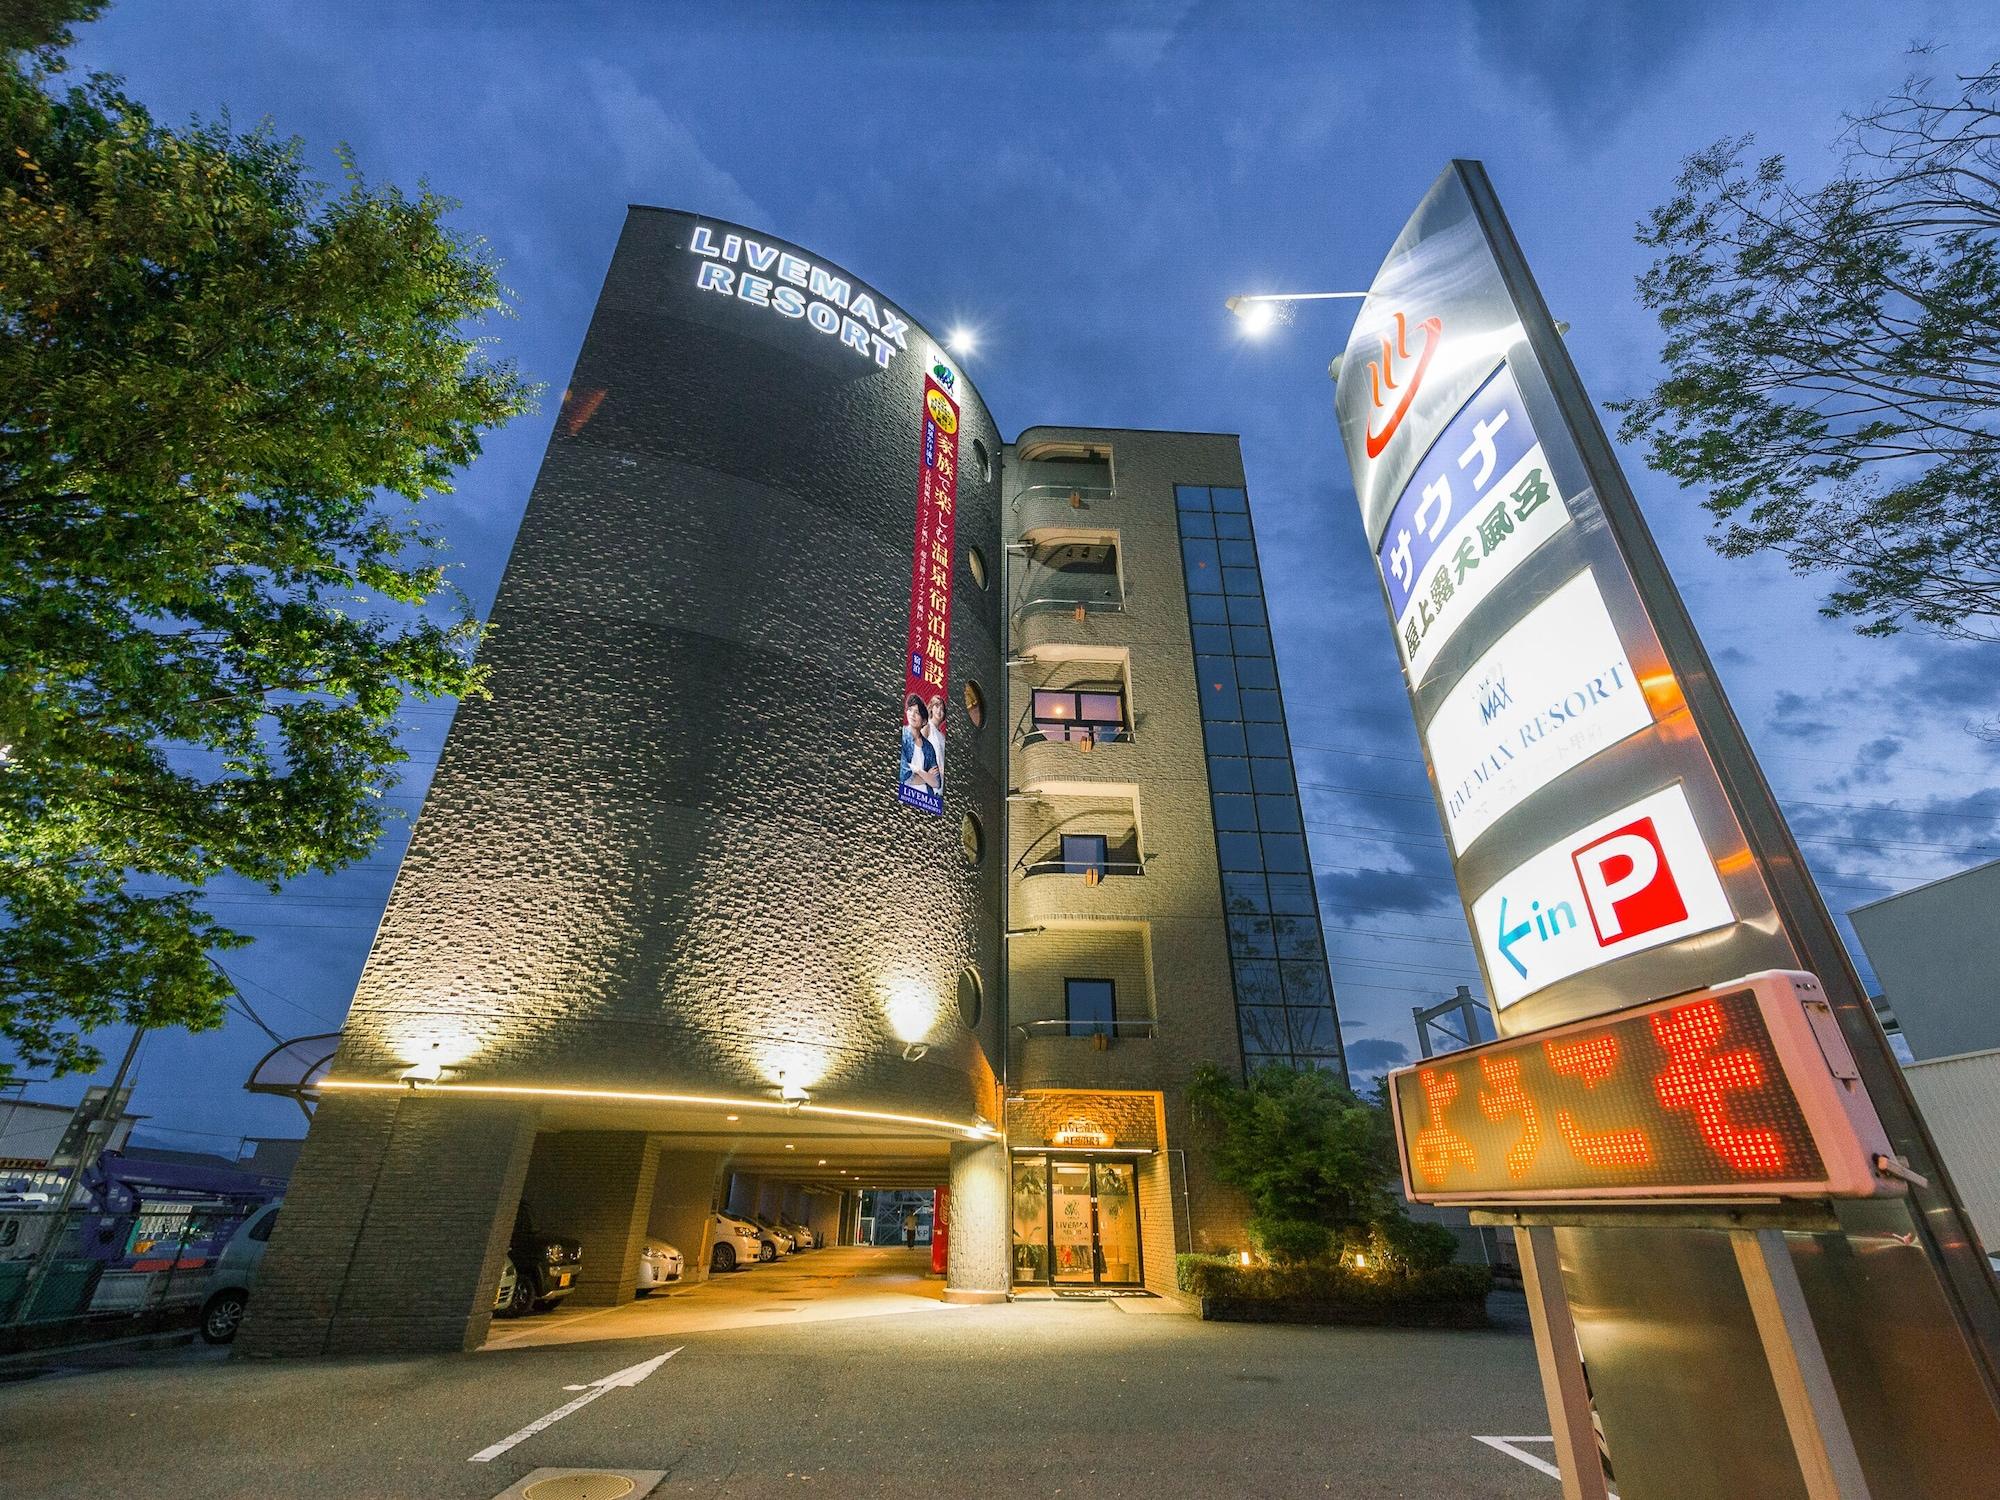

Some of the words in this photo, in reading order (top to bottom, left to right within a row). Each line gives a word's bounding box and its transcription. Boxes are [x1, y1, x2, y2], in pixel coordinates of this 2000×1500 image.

[697, 261, 896, 369] RESORT
[1390, 409, 1511, 594] サウナ
[924, 432, 956, 690] 家族で楽しむ温泉宿泊施設
[1404, 468, 1551, 663] 屋上露天風呂
[912, 655, 921, 675] 宿泊
[1479, 677, 1514, 726] MAX
[1519, 661, 1625, 749] RESORT
[1531, 899, 1577, 942] in
[1576, 833, 1659, 942] P
[1415, 1002, 1784, 1186] ようこそ
